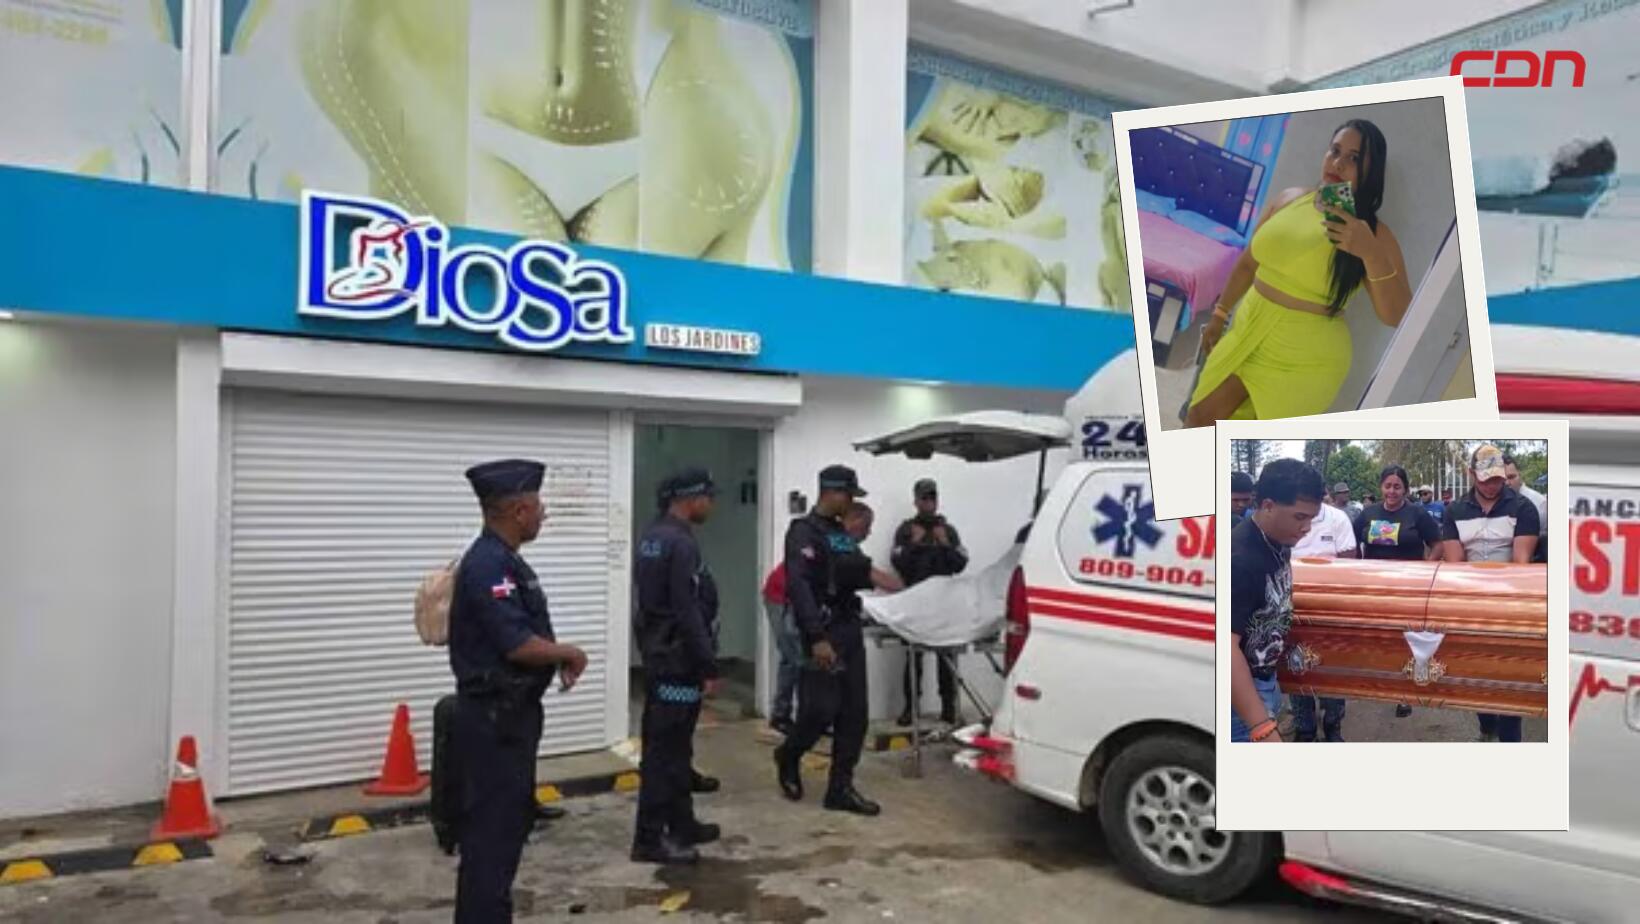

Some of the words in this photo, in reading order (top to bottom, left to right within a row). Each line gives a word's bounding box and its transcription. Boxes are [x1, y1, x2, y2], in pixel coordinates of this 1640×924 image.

[651, 325, 681, 346] LOS
[684, 328, 759, 353] JARDINES
[1081, 420, 1147, 448] 24
[1083, 447, 1149, 461] Horas
[1569, 497, 1640, 519] ANC
[1569, 518, 1640, 596] ST
